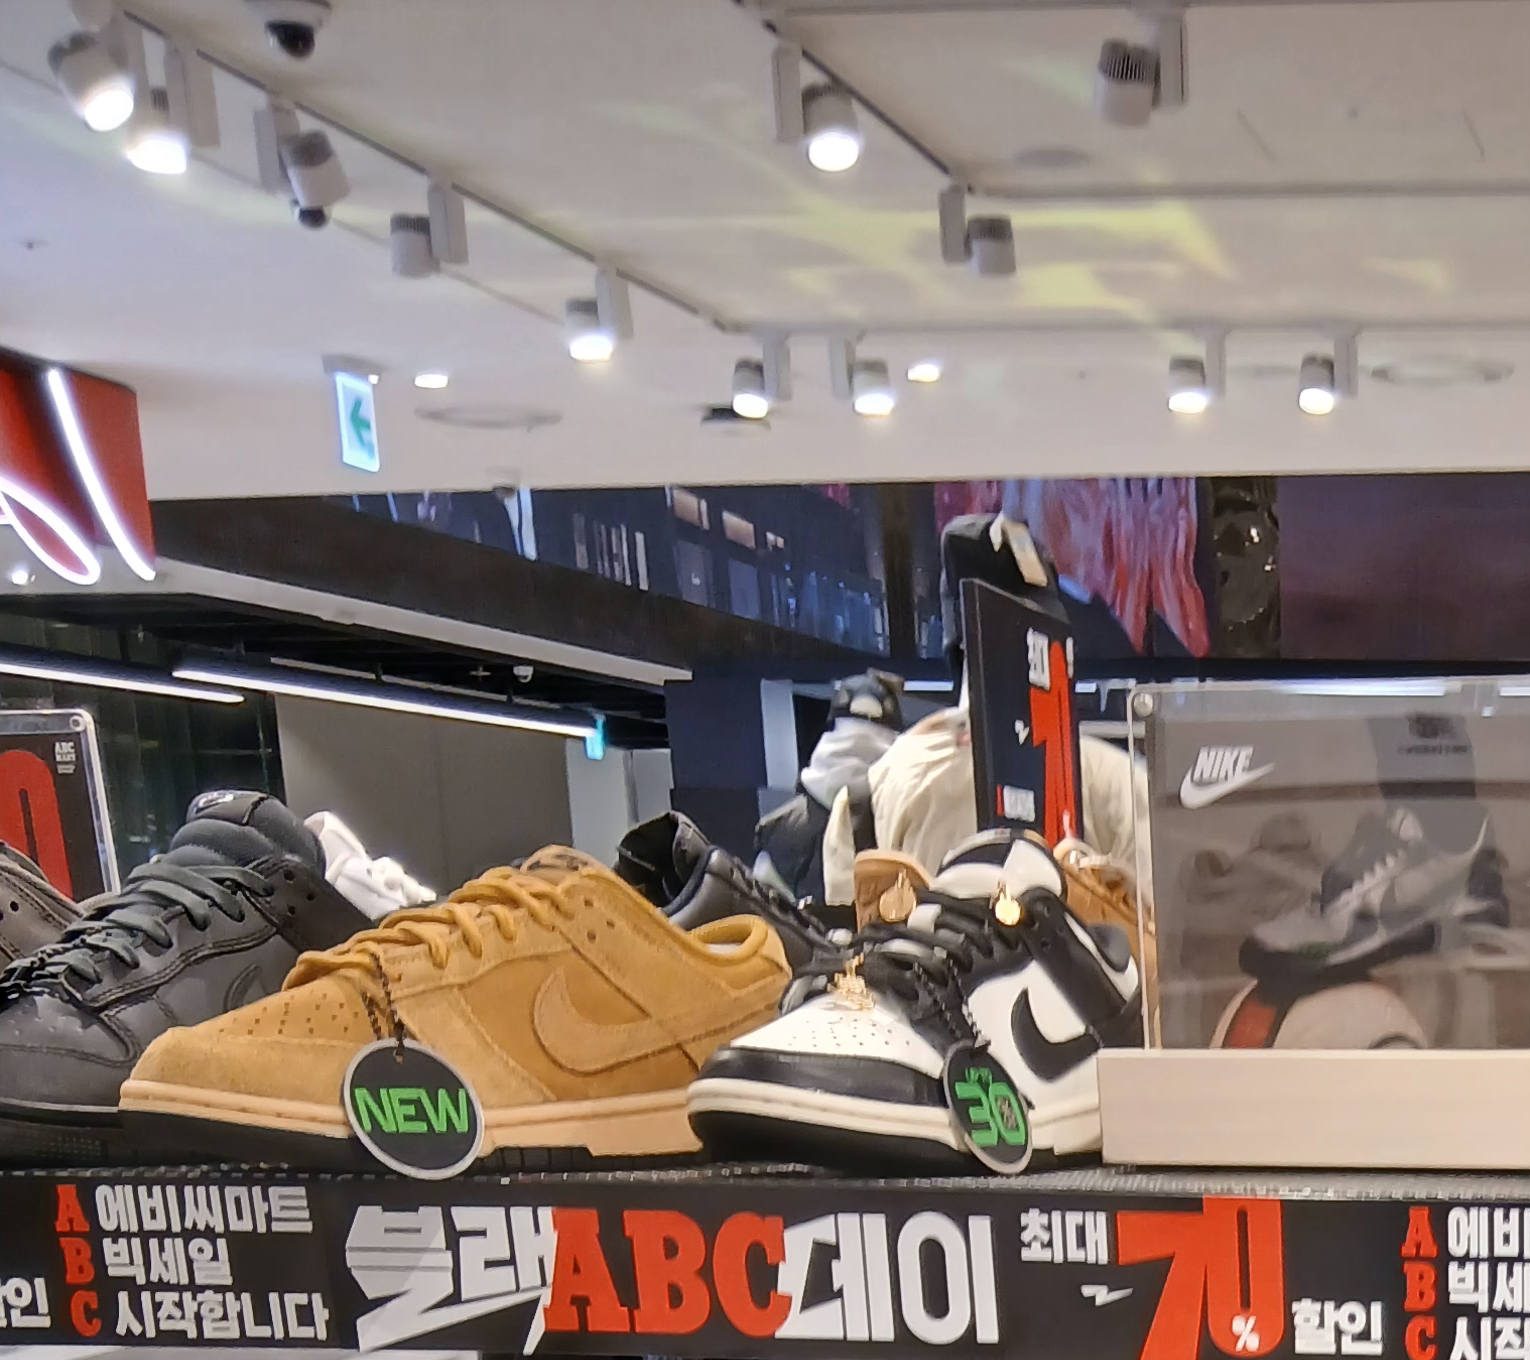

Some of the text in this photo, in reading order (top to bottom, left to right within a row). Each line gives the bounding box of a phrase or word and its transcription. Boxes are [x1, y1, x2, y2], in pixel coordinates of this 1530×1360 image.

[1192, 745, 1254, 783] NIKE
[354, 1087, 470, 1134] NEW
[55, 1185, 314, 1234] A 에비씨마트
[1401, 1205, 1438, 1258] A
[57, 1238, 234, 1286] B 빅세일
[1019, 1207, 1109, 1266] 최대
[1291, 1297, 1383, 1357] 할인
[1402, 1262, 1438, 1313] B
[71, 1290, 329, 1341] C 시작합니다
